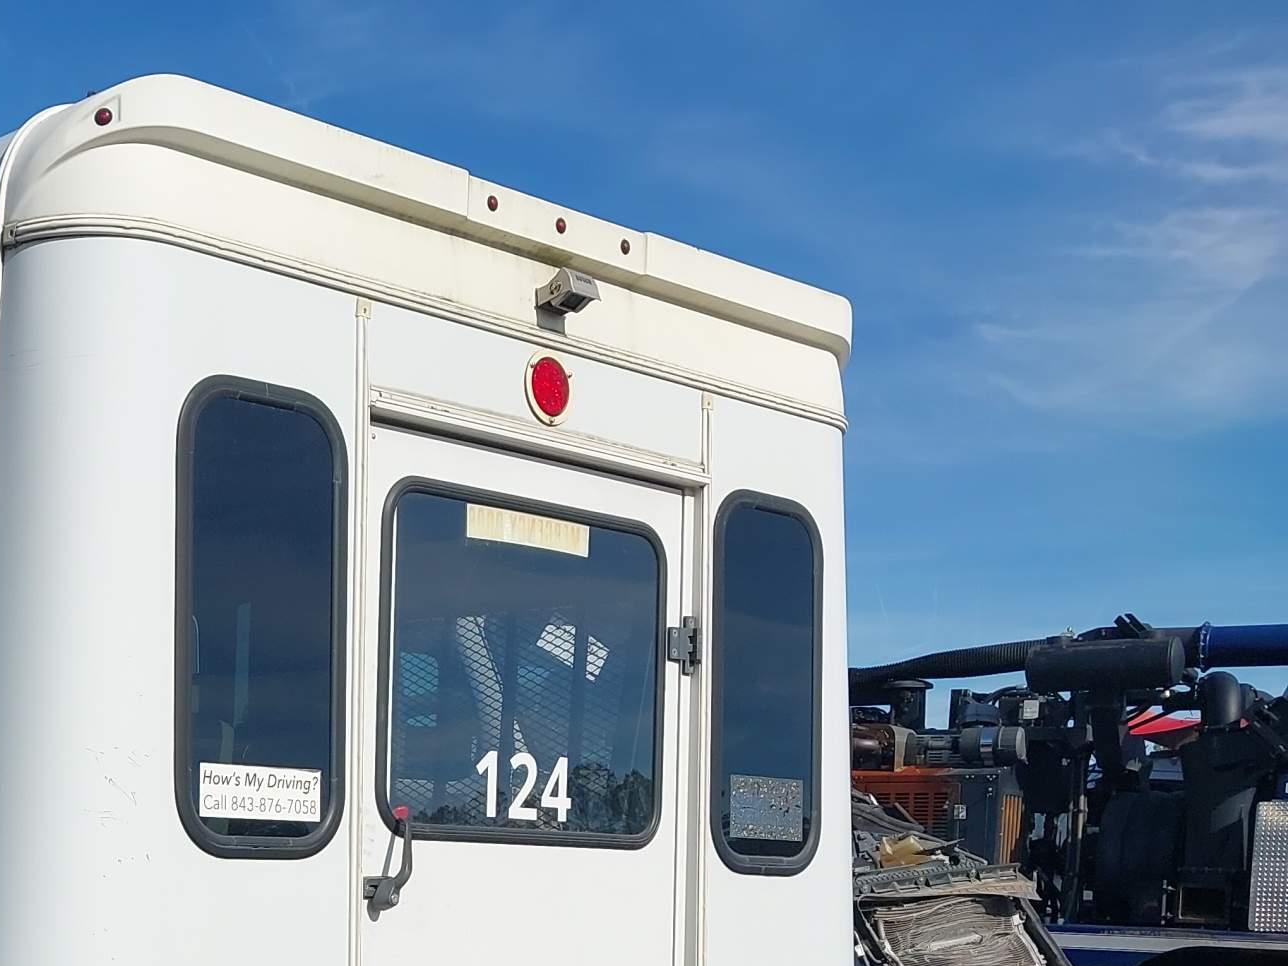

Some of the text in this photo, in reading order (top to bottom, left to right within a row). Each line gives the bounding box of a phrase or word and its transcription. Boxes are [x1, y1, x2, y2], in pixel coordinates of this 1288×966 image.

[202, 769, 319, 795] How's My Driving?
[475, 750, 572, 822] 124
[203, 794, 317, 815] Call 843-876-7058
